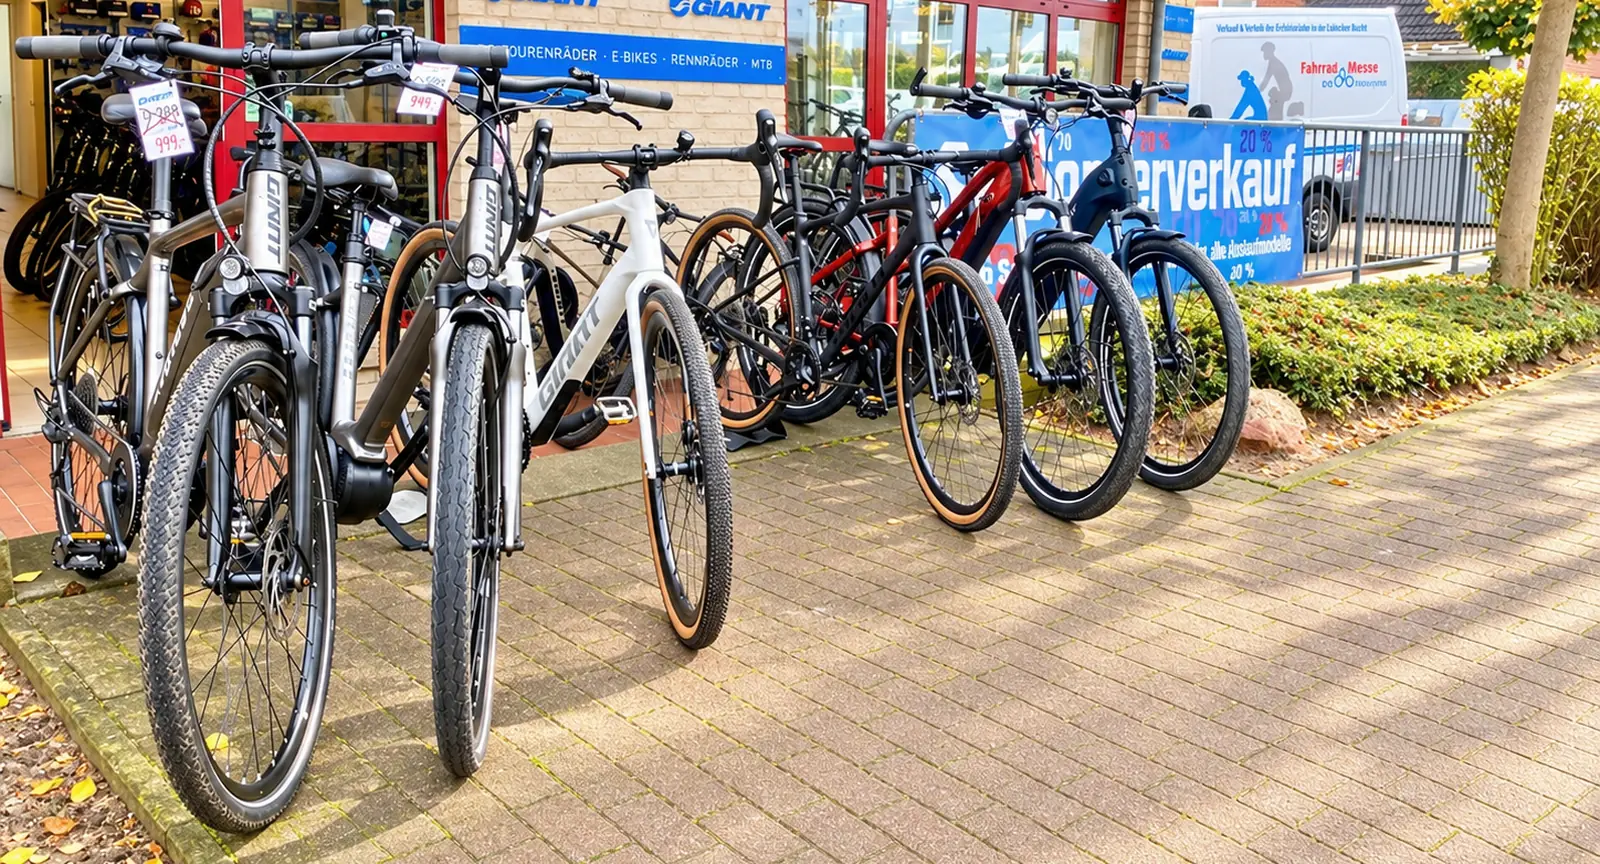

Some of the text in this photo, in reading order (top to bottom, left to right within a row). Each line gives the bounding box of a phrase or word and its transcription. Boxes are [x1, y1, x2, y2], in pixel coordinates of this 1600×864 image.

[691, 0, 771, 22] GIANT
[508, 44, 773, 71] OURENRÄDER E-BIKES RENNRÄDER MTB
[1300, 60, 1379, 75] Fahrrad Messe
[1240, 129, 1272, 153] 20 %
[1006, 127, 1297, 218] oerverkauf
